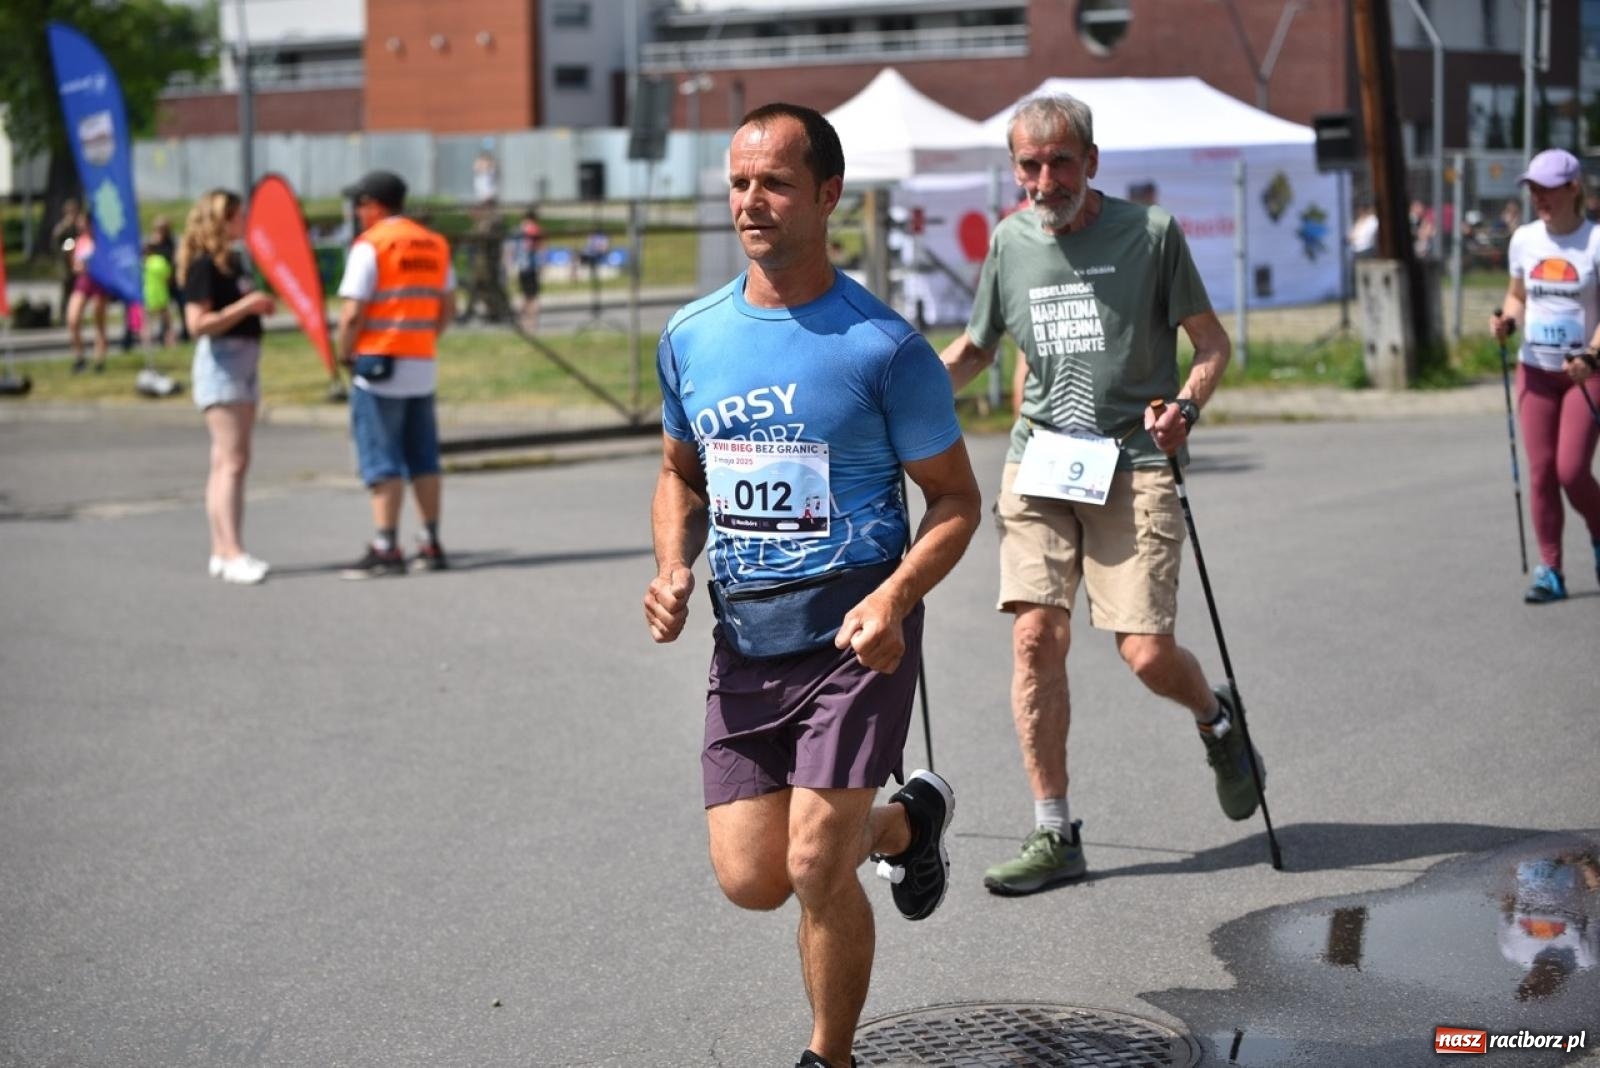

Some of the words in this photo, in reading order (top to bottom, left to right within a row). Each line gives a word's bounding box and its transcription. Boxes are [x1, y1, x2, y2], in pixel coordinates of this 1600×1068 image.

[1030, 299, 1099, 324] MARATONA
[1033, 324, 1046, 342] DI
[1047, 318, 1104, 340] RAVENNA
[713, 442, 729, 452] XVII
[731, 443, 753, 453] BIEG
[755, 444, 774, 454] BEZ
[776, 444, 819, 455] GRANIC
[734, 480, 792, 511] 012
